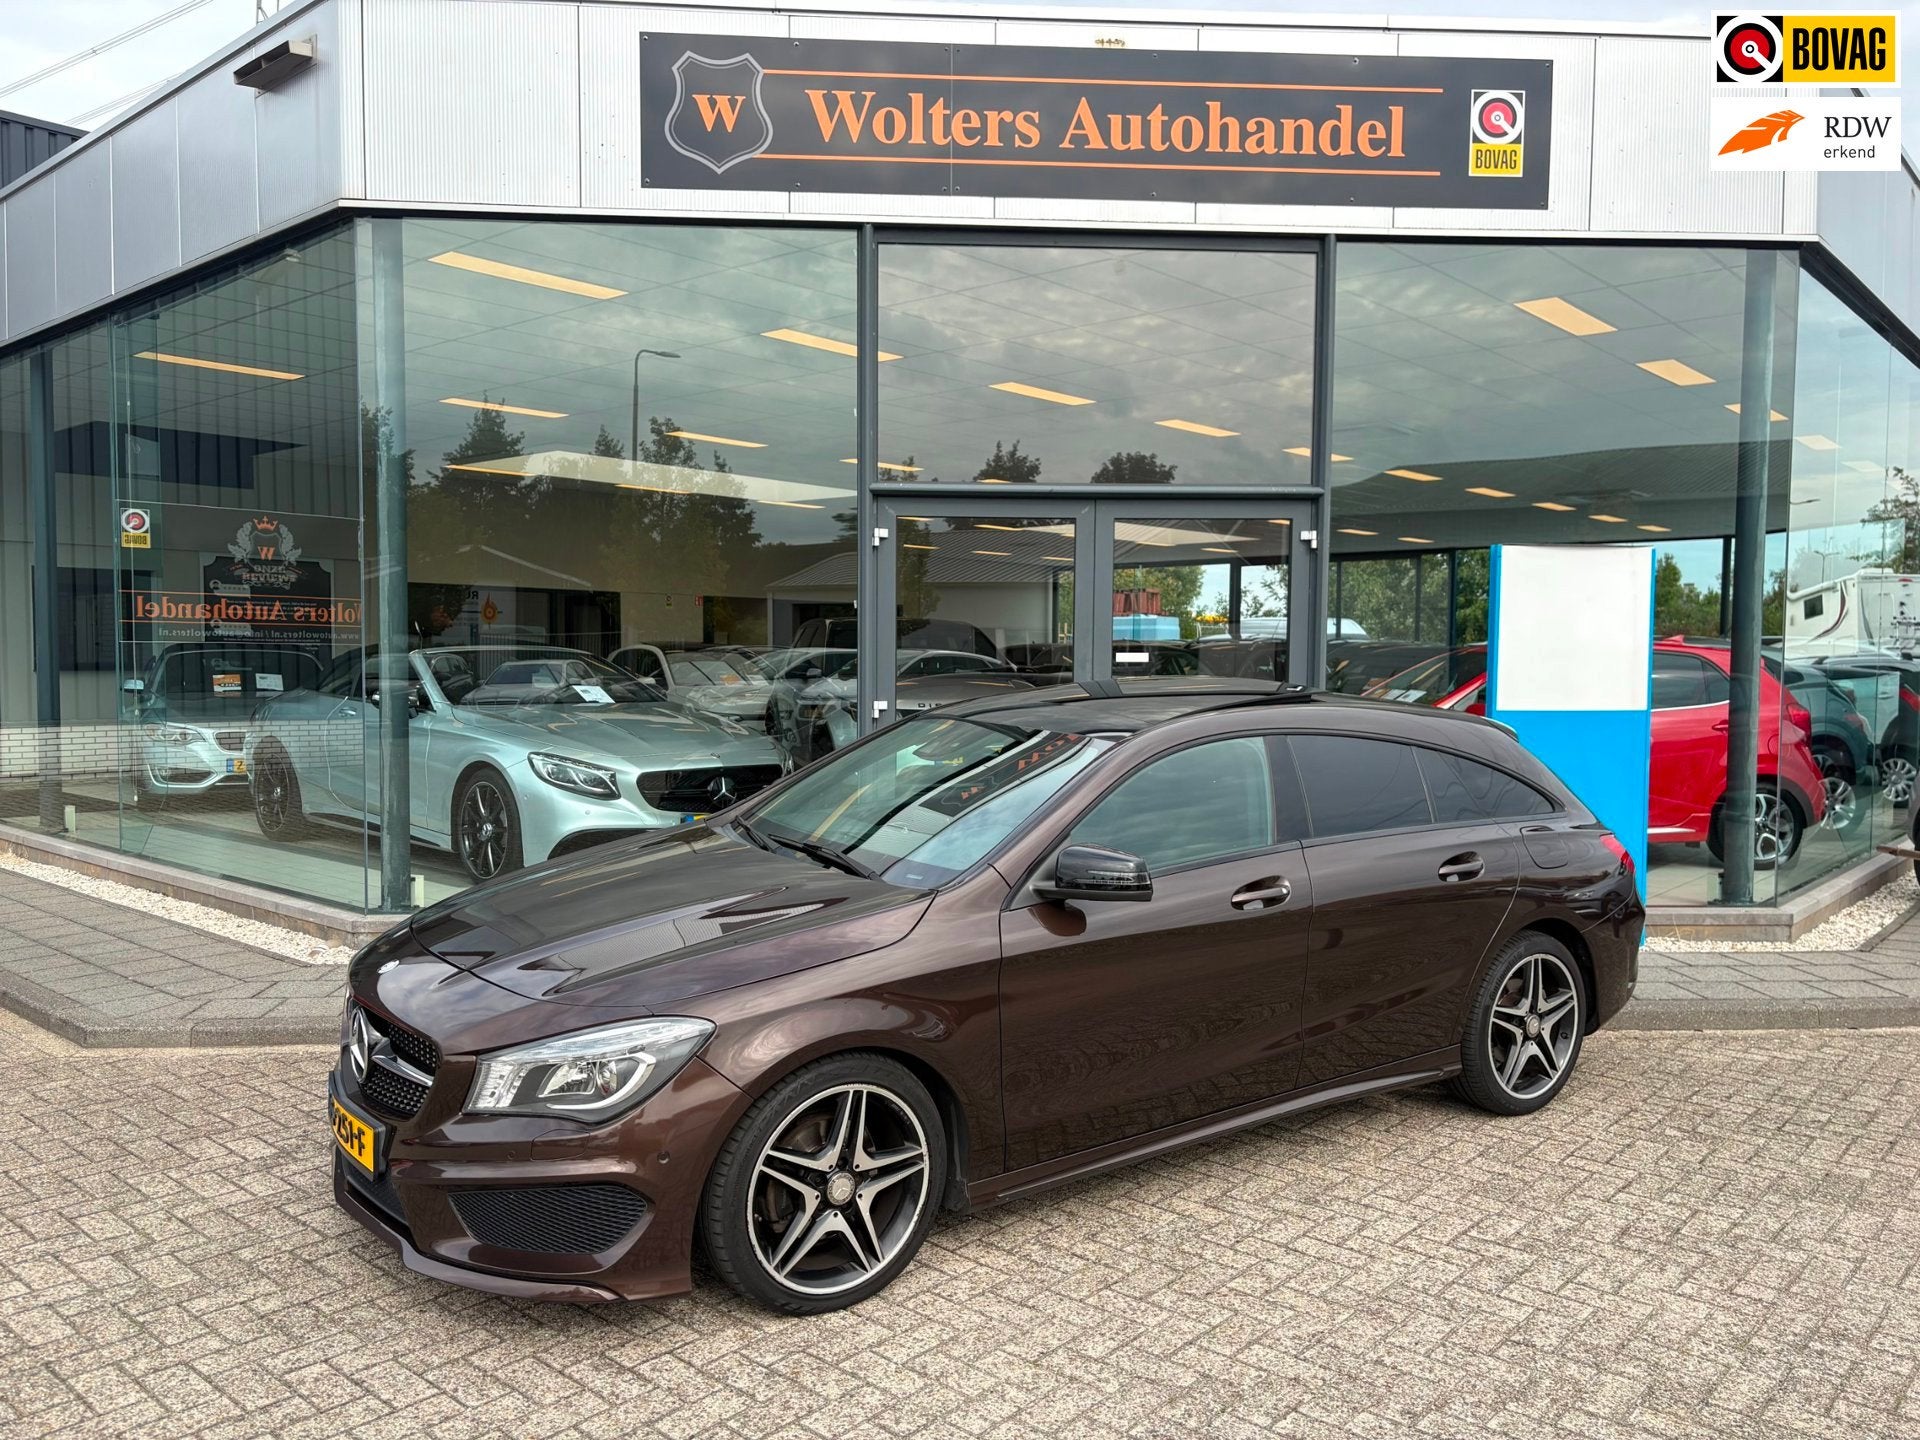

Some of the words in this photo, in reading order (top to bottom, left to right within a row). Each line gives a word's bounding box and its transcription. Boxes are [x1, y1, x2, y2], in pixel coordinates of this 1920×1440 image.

[692, 94, 746, 133] W
[804, 89, 1041, 148] Wolters
[1058, 96, 1406, 158] Autohandel
[1475, 149, 1518, 170] BOVAG
